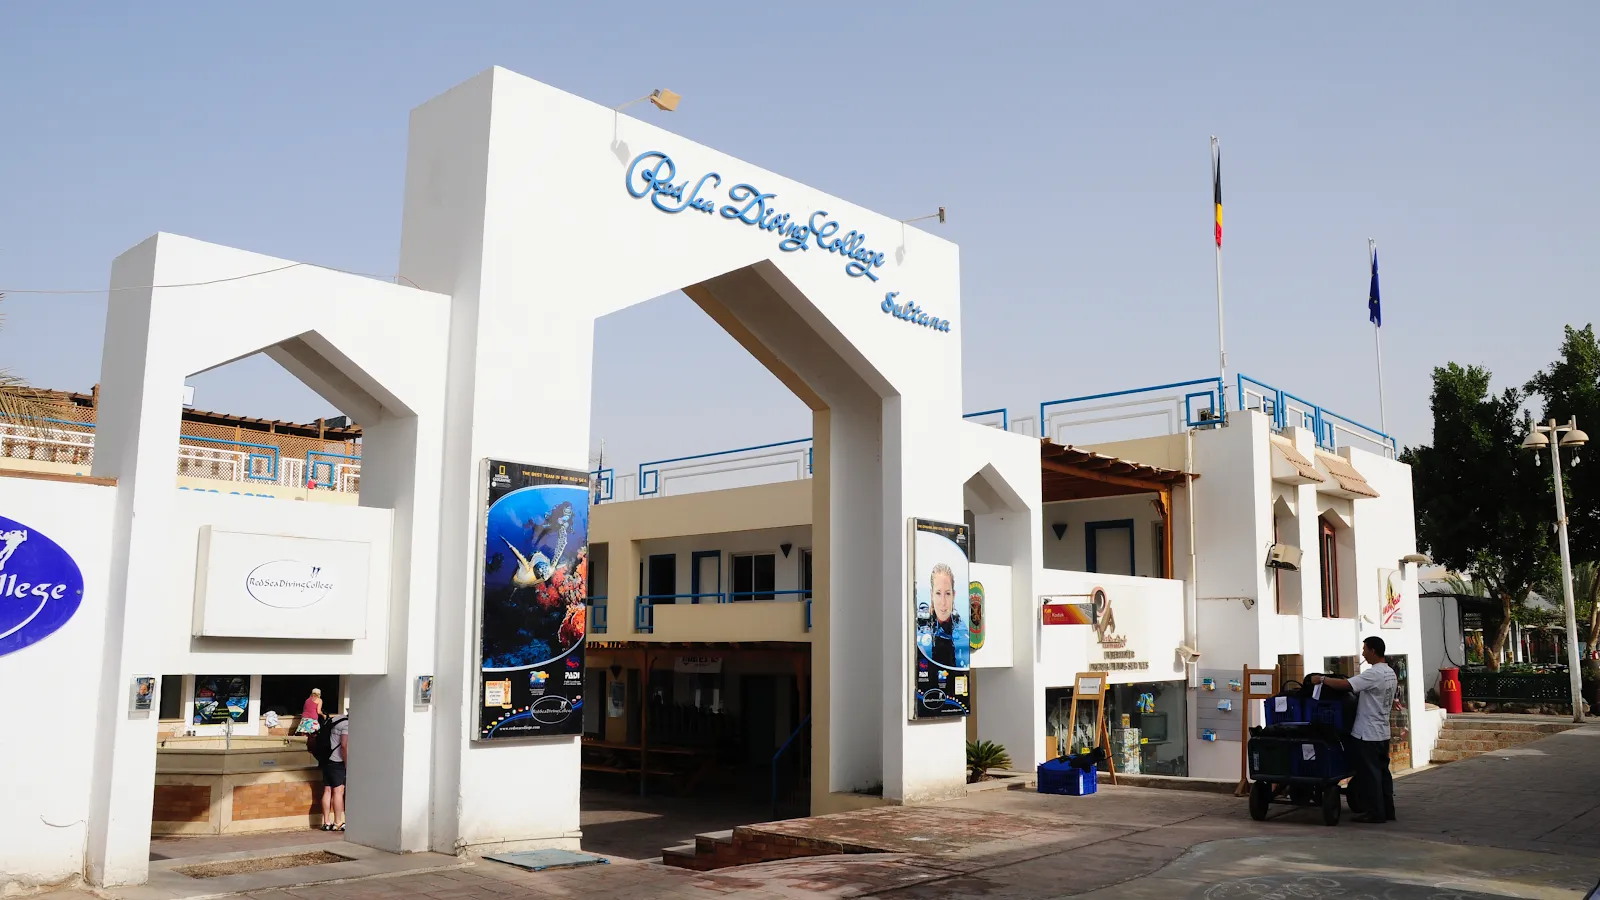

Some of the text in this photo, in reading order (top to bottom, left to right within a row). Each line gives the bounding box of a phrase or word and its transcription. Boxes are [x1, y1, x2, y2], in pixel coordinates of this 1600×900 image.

[626, 150, 886, 282] Red Sea Diving College
[881, 291, 952, 333] Sultana
